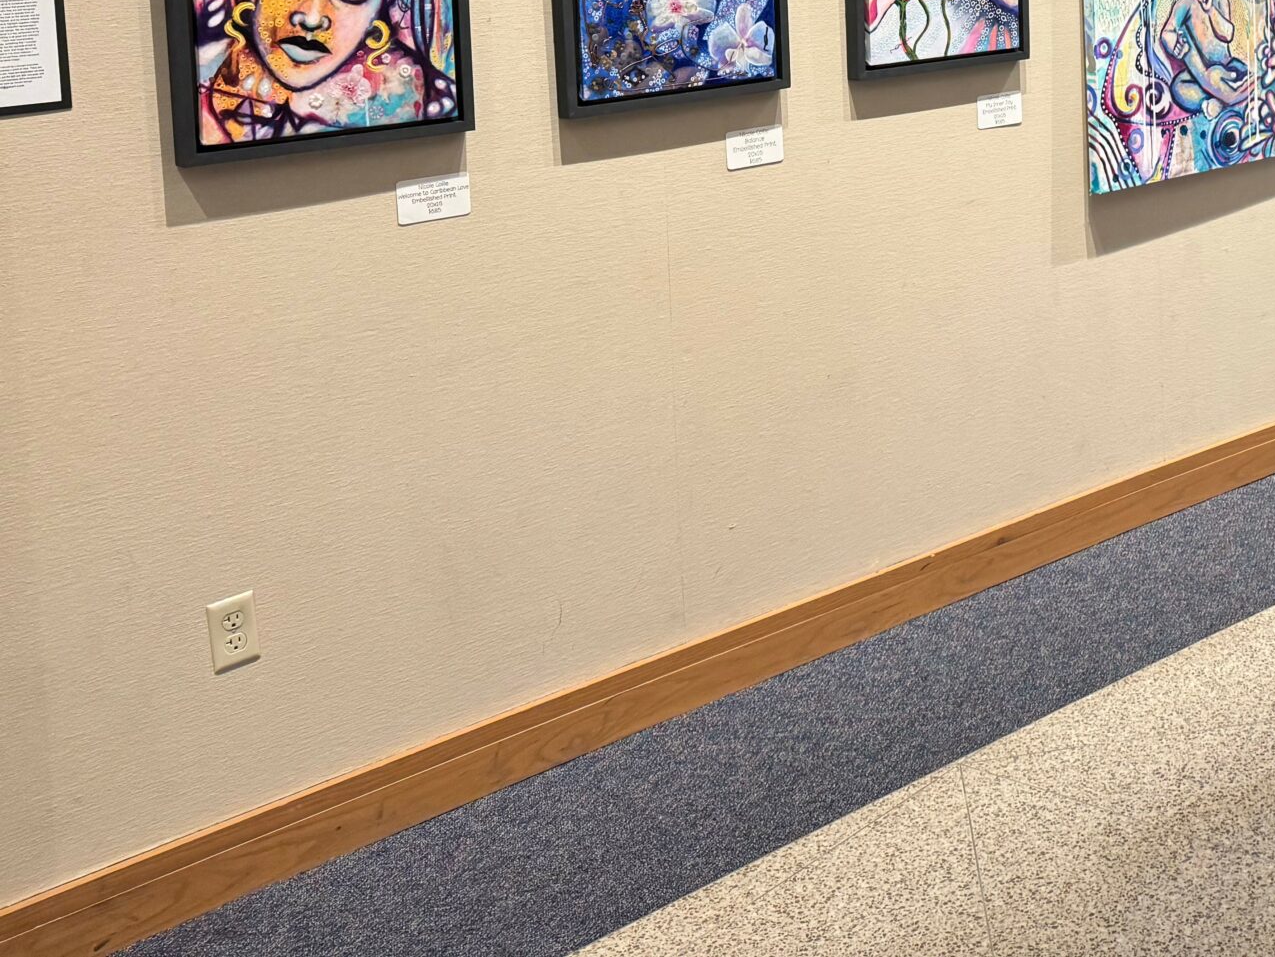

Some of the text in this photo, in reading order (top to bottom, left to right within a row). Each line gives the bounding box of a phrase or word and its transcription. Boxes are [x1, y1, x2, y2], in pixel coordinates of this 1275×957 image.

[398, 191, 421, 200] Welcome
[430, 186, 456, 194] Caribbean
[411, 195, 442, 204] Embellished
